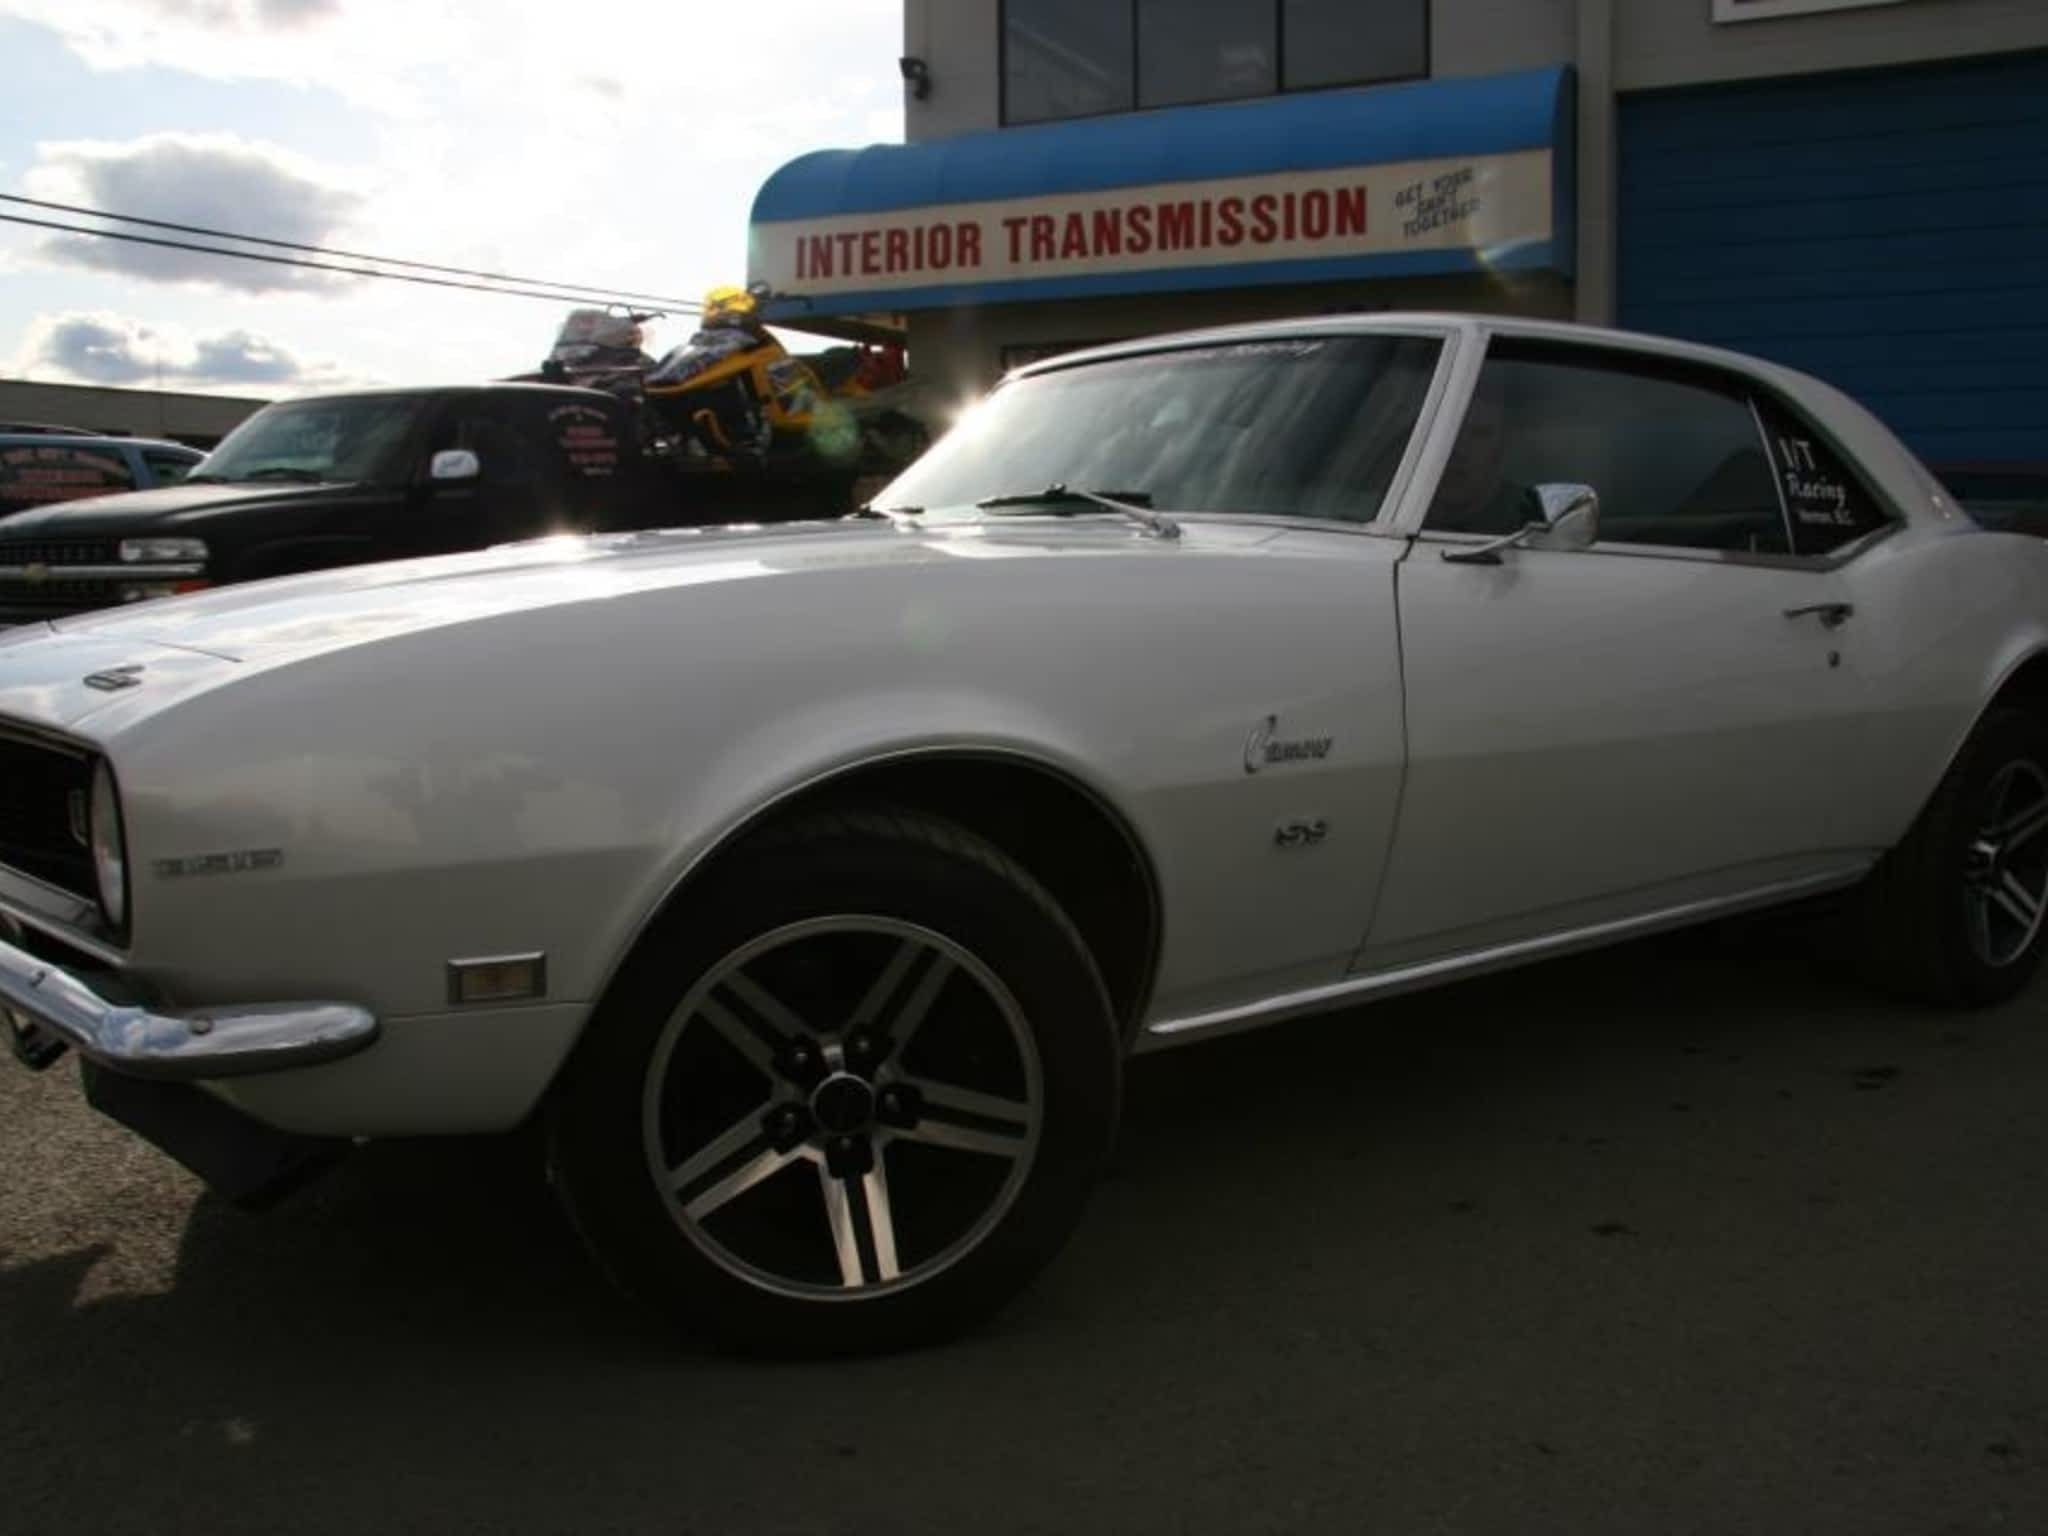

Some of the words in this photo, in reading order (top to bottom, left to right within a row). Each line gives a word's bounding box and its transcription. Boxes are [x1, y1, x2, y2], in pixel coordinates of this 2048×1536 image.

[795, 221, 982, 279] INTERIOR
[1002, 186, 1366, 264] TRANSMISSION
[1785, 473, 1846, 509] Racing
